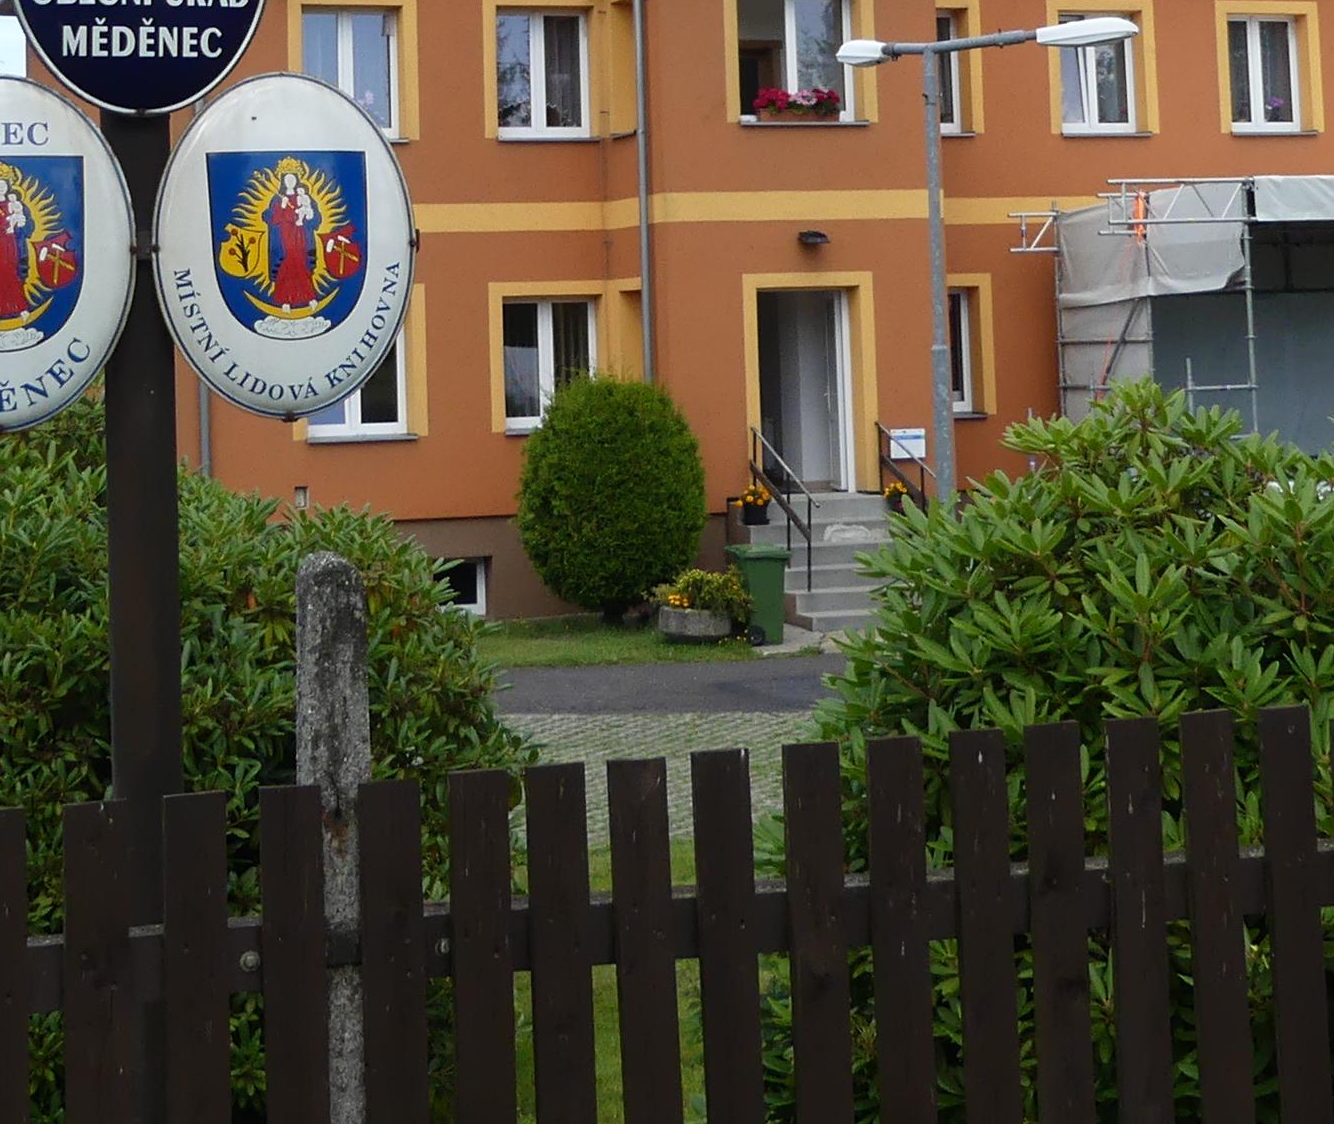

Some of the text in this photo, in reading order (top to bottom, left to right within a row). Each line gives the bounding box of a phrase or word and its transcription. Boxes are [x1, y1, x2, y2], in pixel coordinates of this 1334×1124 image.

[62, 18, 223, 58] MĚDĚNEC
[174, 261, 401, 401] MÍSTNÍ LIDOVÁ KNIHOVNA
